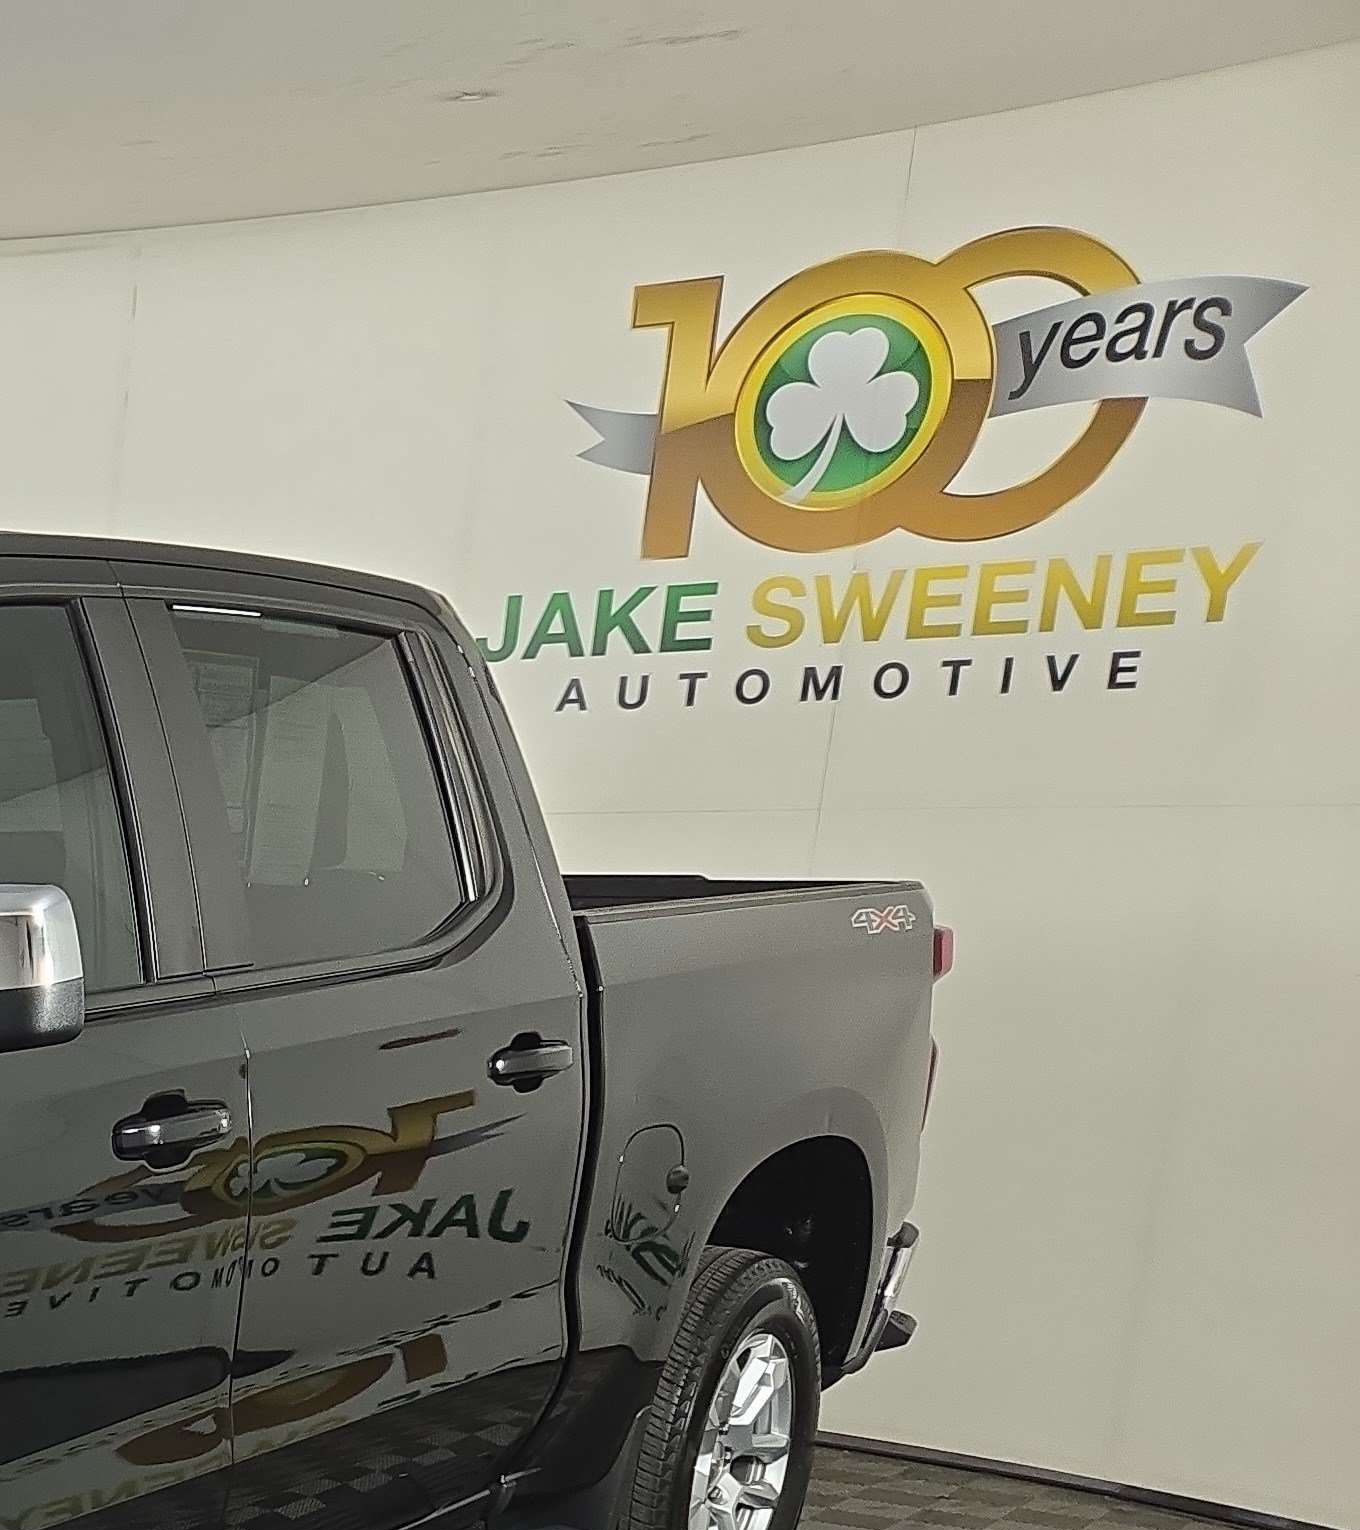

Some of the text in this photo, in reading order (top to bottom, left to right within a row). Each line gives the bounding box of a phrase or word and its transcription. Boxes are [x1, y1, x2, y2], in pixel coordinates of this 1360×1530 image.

[1008, 293, 1234, 400] years
[476, 542, 1264, 663] JAKE SWEENEY
[555, 650, 1143, 712] AUTOMOTIVE
